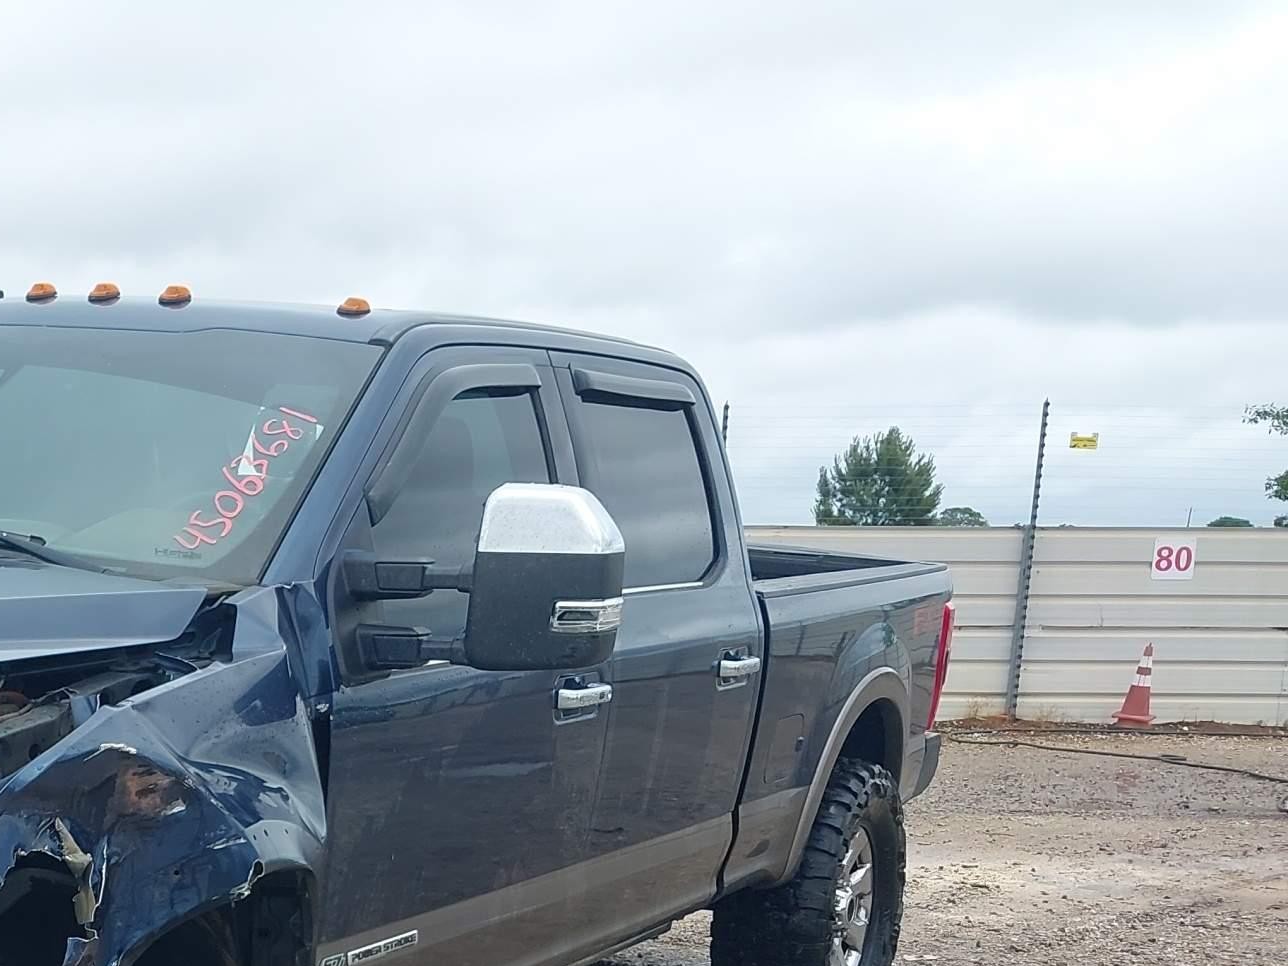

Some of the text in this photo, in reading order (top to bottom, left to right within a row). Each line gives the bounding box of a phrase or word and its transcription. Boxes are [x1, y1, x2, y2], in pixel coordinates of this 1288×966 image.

[173, 406, 318, 550] 45063681
[1154, 546, 1193, 572] 80
[351, 945, 382, 962] POWER
[383, 935, 416, 951] STROKE
